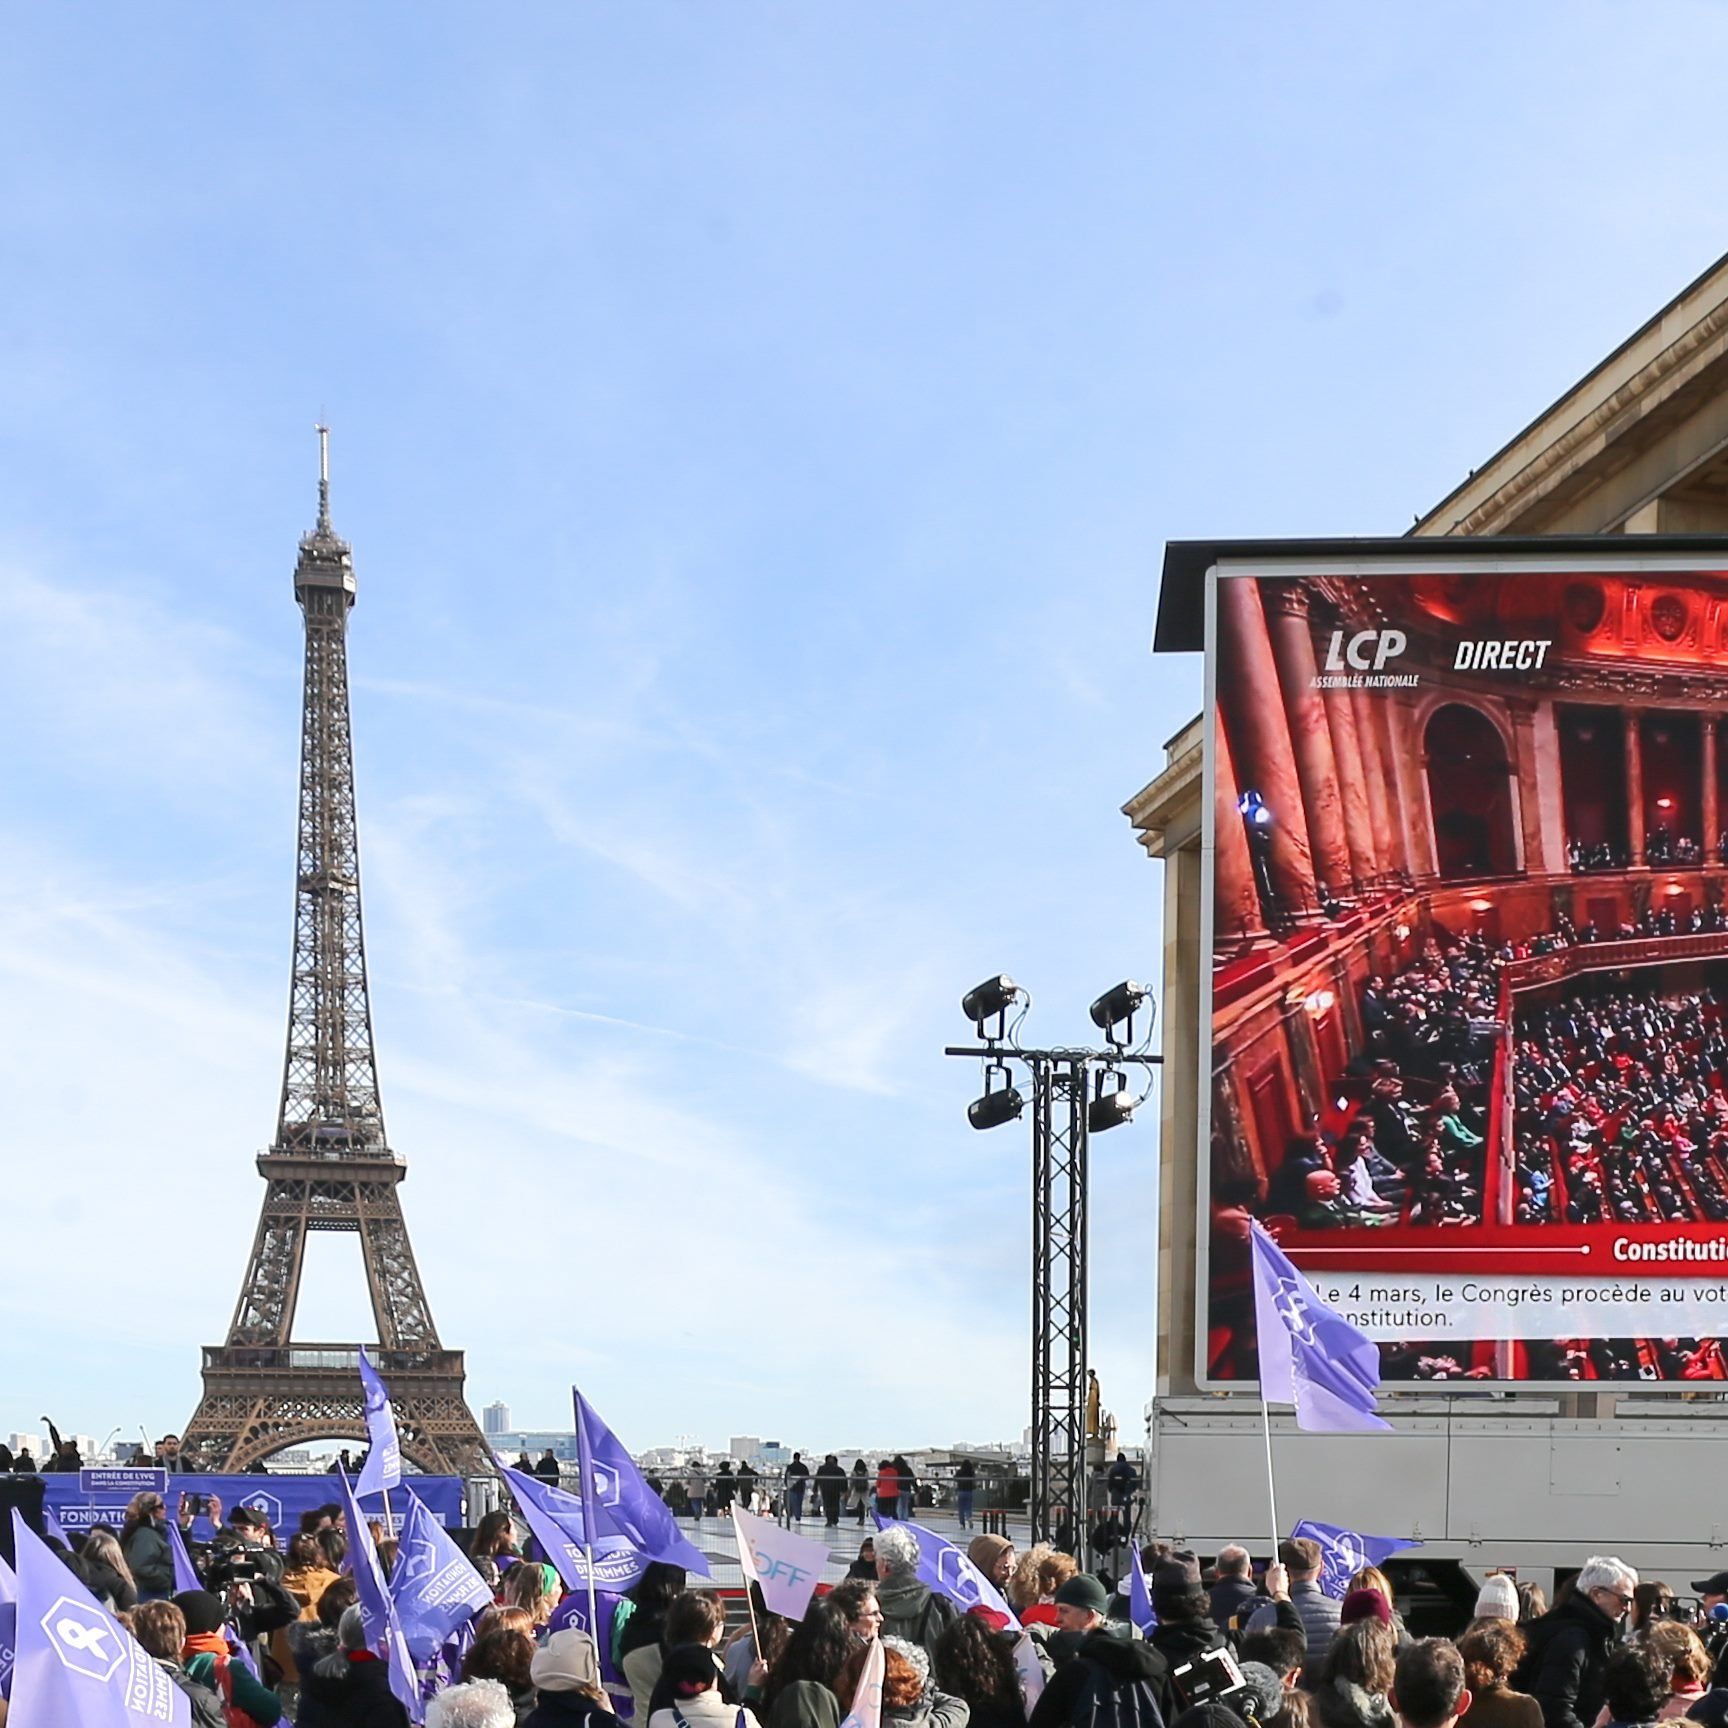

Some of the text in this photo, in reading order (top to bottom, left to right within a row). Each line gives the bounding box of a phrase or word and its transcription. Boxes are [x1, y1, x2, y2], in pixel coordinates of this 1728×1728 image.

[1324, 629, 1406, 671] LCP
[1453, 640, 1552, 670] DIRECT
[1309, 674, 1419, 688] ASSEMBLÉE NATIONALE
[1348, 1284, 1361, 1302] 4
[1370, 1288, 1427, 1306] mars,
[1435, 1284, 1454, 1302] le
[1461, 1284, 1552, 1307] Congrès
[1562, 1284, 1652, 1307] procède
[1660, 1289, 1684, 1303] au
[1337, 1308, 1454, 1328] nstitution.
[122, 1472, 134, 1480] DE
[59, 1511, 126, 1523] FONDATI
